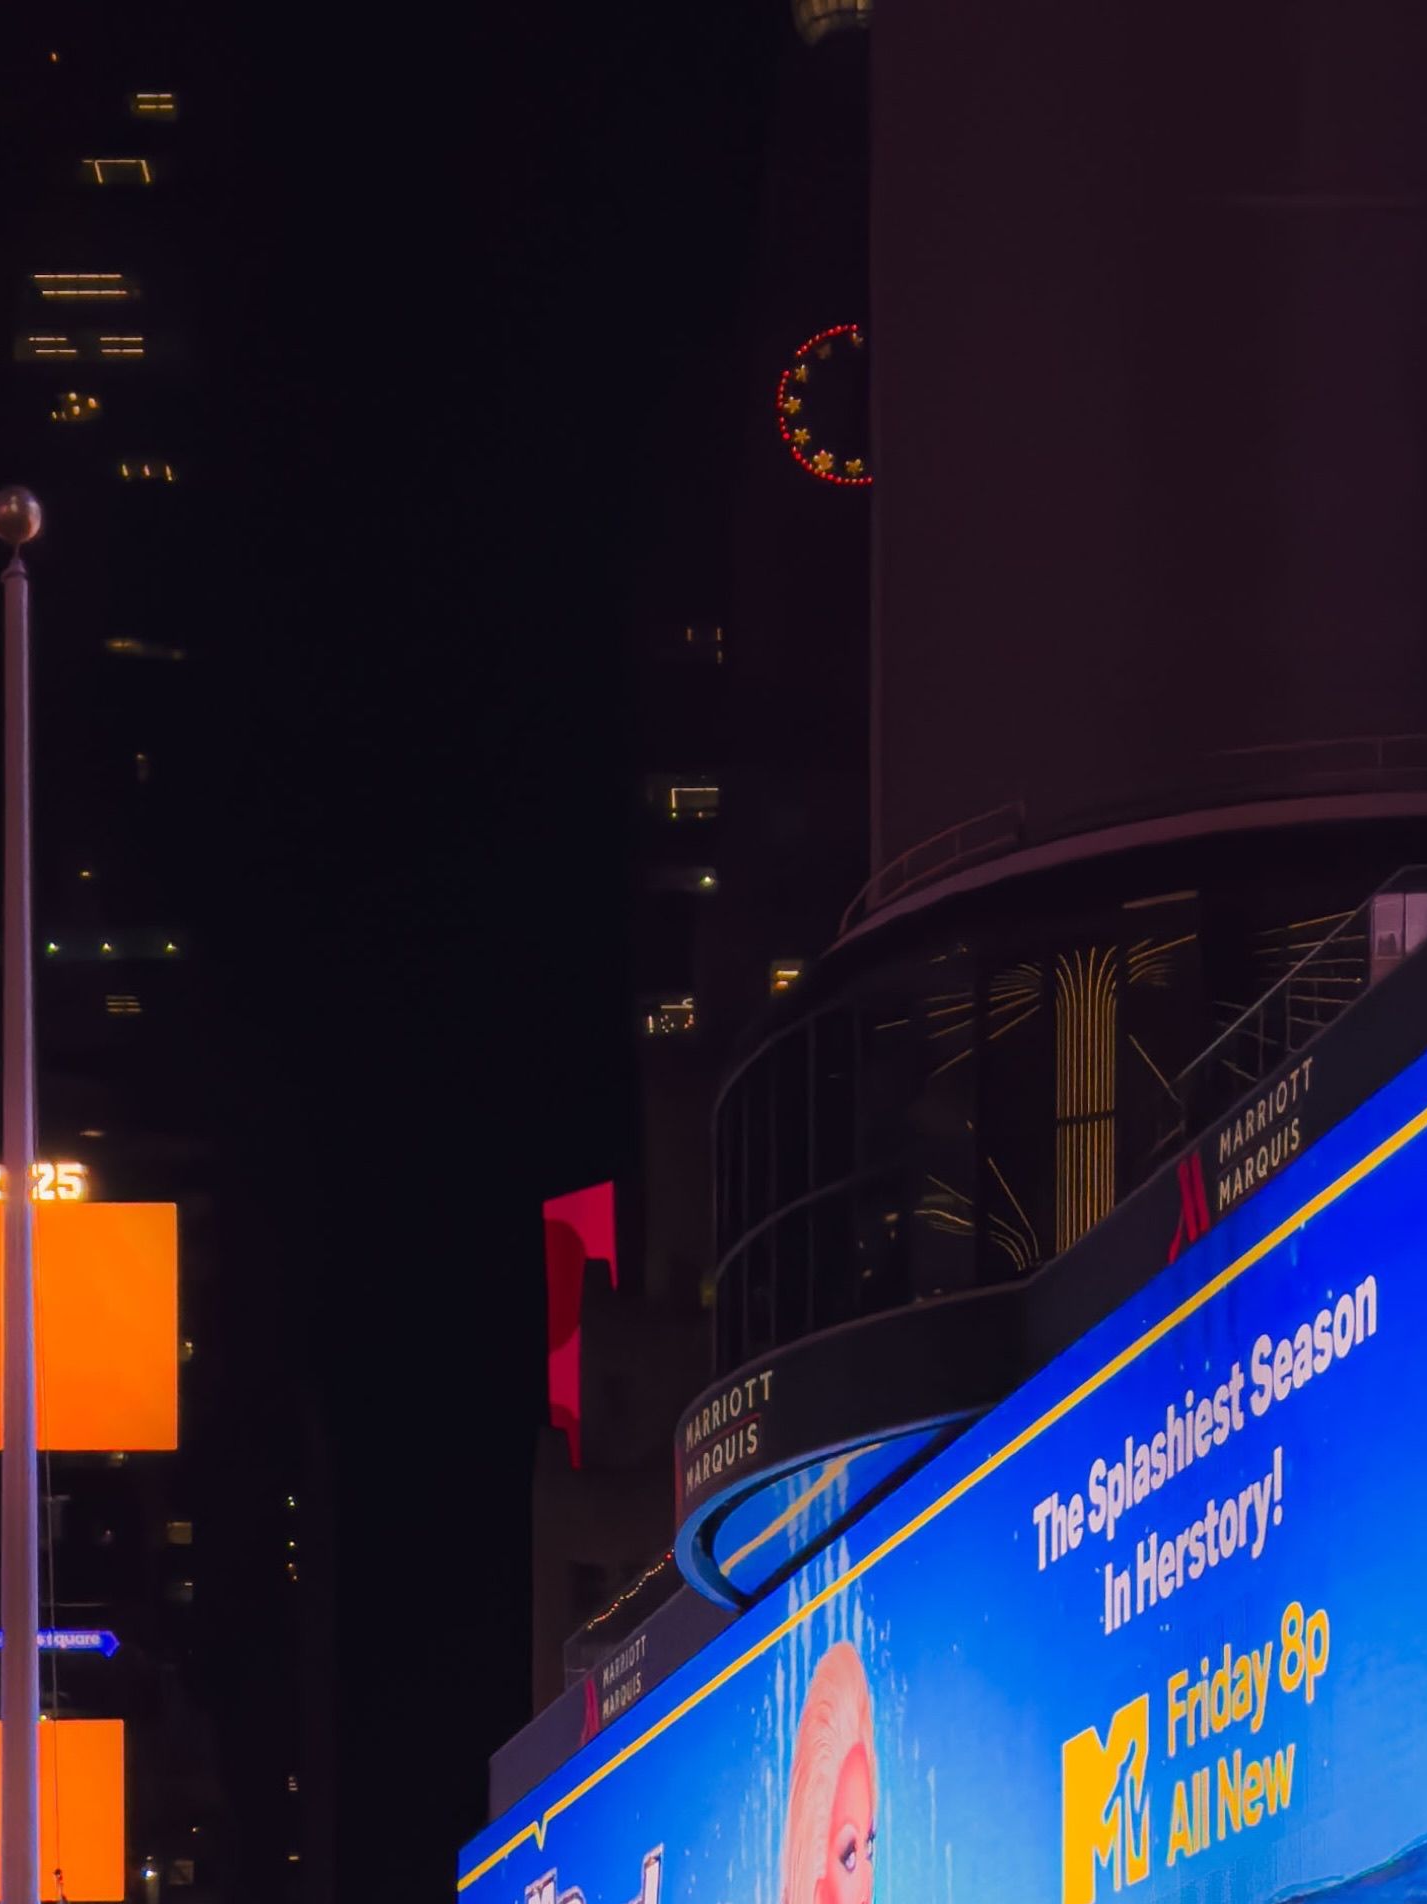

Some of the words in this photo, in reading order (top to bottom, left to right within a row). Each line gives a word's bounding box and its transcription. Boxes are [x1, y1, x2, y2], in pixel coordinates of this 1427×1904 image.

[1219, 1056, 1313, 1164] MARRIOTT
[1218, 1118, 1301, 1212] MARQUIS
[684, 1422, 759, 1497] MARQUIS
[685, 1370, 773, 1453] MARRIOTT
[1032, 1490, 1084, 1571] The
[1088, 1361, 1245, 1541] Splashiest
[1249, 1274, 1378, 1416] Season
[1103, 1561, 1132, 1635] In
[1135, 1446, 1285, 1614] Herstory!
[602, 1635, 647, 1689] MARRIOTT
[602, 1672, 642, 1720] MARQUIS
[1166, 1640, 1273, 1757] Friday
[1278, 1600, 1331, 1704] 8p
[1166, 1766, 1211, 1868] All
[1216, 1743, 1297, 1843] New
